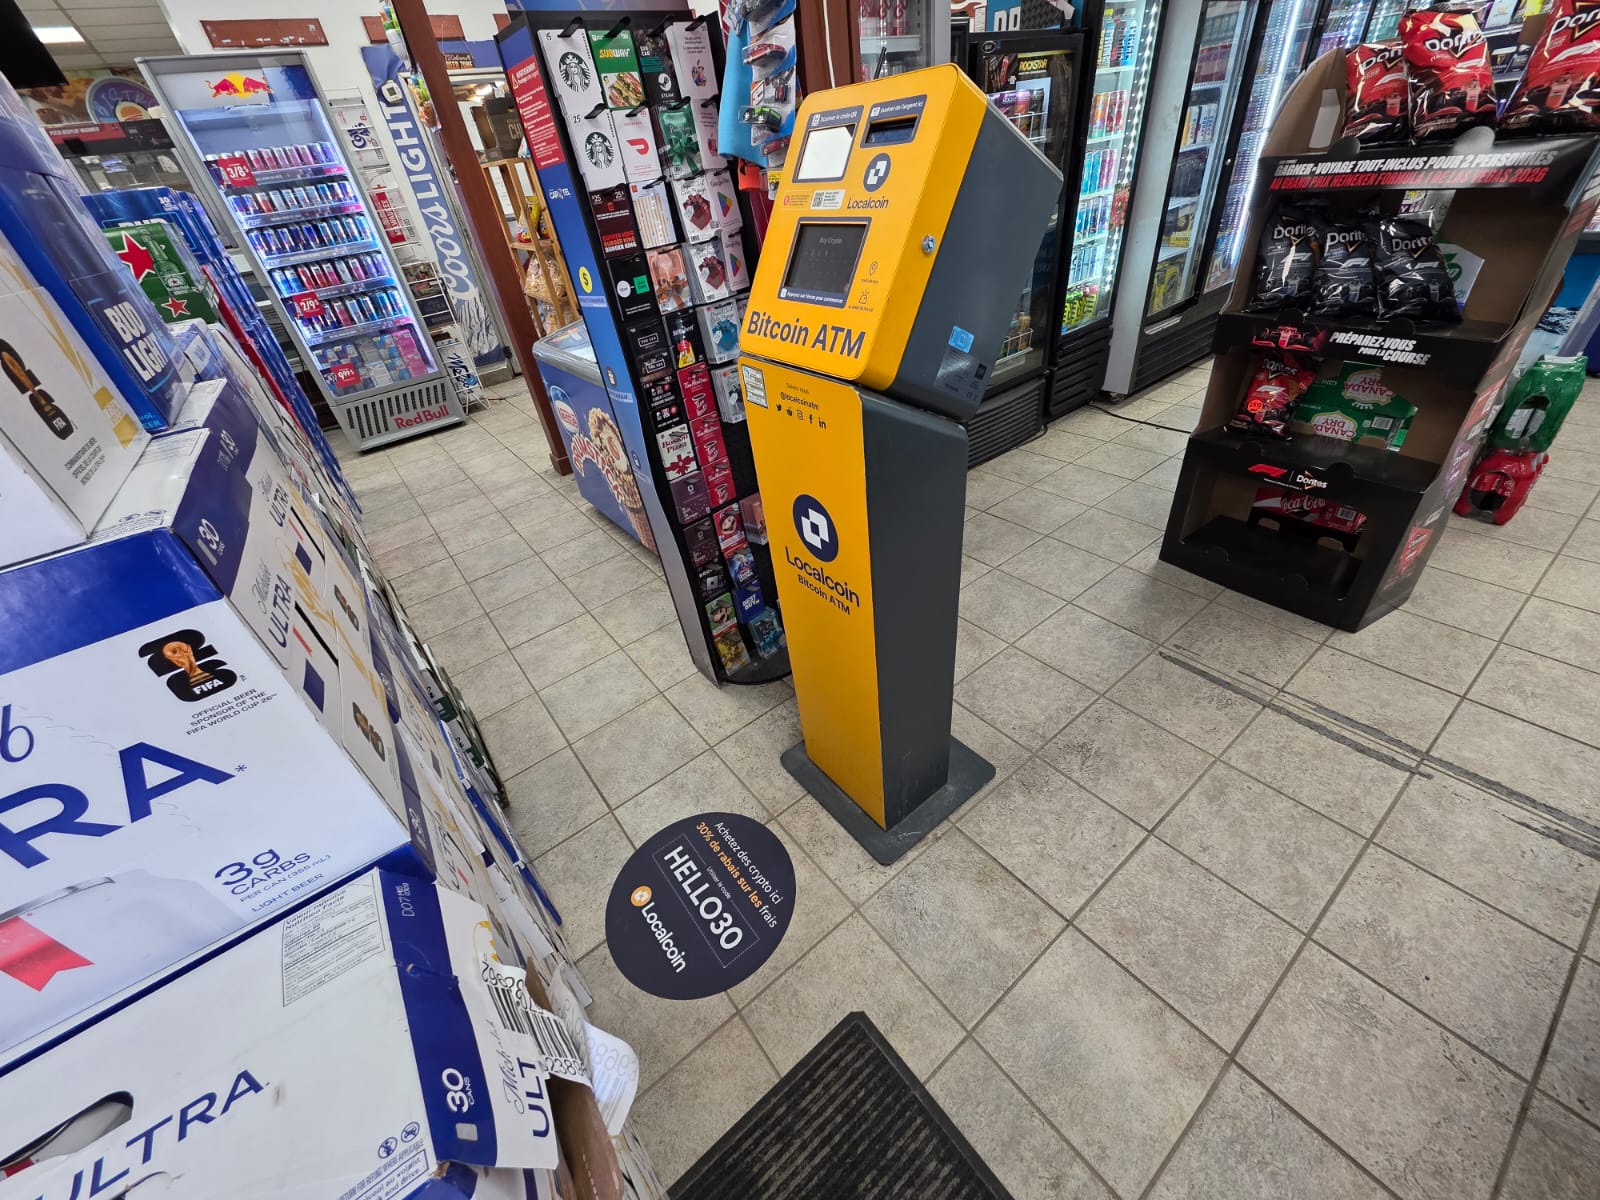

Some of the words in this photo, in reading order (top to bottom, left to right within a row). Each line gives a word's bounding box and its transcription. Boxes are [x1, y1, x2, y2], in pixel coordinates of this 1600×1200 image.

[599, 48, 631, 59] SUBWAY
[1018, 59, 1048, 72] ROCKSTAR
[380, 101, 442, 201] LIGHT
[1424, 155, 1463, 169] POUR
[1460, 154, 1475, 168] 2
[1471, 151, 1558, 168] PERSONNES
[1375, 170, 1425, 185] FORMULA
[1471, 168, 1512, 184] VEGAS
[1509, 167, 1549, 183] 2026
[847, 195, 889, 210] Localcoin
[625, 242, 638, 250] KING
[104, 301, 147, 343] BUD
[747, 310, 810, 347] Bitcoin
[811, 323, 866, 359] ATM
[123, 332, 169, 382] LIGHT
[1382, 349, 1431, 366] COURSE
[394, 409, 423, 430] Red
[423, 404, 449, 424] Bull
[1322, 418, 1347, 428] DRY
[1296, 475, 1328, 489] Doritos
[269, 483, 290, 527] ULTRA
[785, 545, 860, 608] Localcoin
[268, 574, 293, 649] ULTRA
[797, 574, 828, 600] Bitcoin
[829, 595, 850, 615] ATM
[191, 700, 234, 719] OFFICIAL
[233, 688, 258, 703] BEER
[192, 679, 224, 695] FIFA
[186, 725, 208, 736] FIFA
[207, 711, 241, 727] WORLD
[241, 702, 260, 712] CUP
[190, 705, 236, 727] SPONSOR
[235, 699, 249, 708] OF
[249, 691, 267, 702] THE
[215, 849, 281, 886] 3g
[231, 852, 311, 895] CARBS
[696, 821, 715, 842] 30%
[709, 840, 721, 853] de
[717, 851, 741, 879] rabais
[737, 876, 753, 893] sur
[748, 890, 763, 909] les
[758, 905, 779, 928] frais
[715, 822, 741, 854] Achetez
[737, 850, 752, 867] des
[748, 865, 773, 893] crypto
[769, 889, 784, 905] ici
[240, 890, 262, 902] PER
[263, 878, 287, 891] CAN
[251, 891, 289, 912] LIGHT
[290, 873, 324, 892] BEER
[663, 845, 743, 950] HELLO30
[720, 886, 731, 899] code
[285, 910, 321, 931] Nutrition
[322, 896, 345, 910] Facts
[640, 901, 688, 974] Localcoin
[441, 1067, 470, 1114] 30
[463, 1076, 476, 1106] CANS
[356, 1178, 367, 1193] FOR
[385, 1177, 396, 1187] au
[385, 1181, 399, 1197] and
